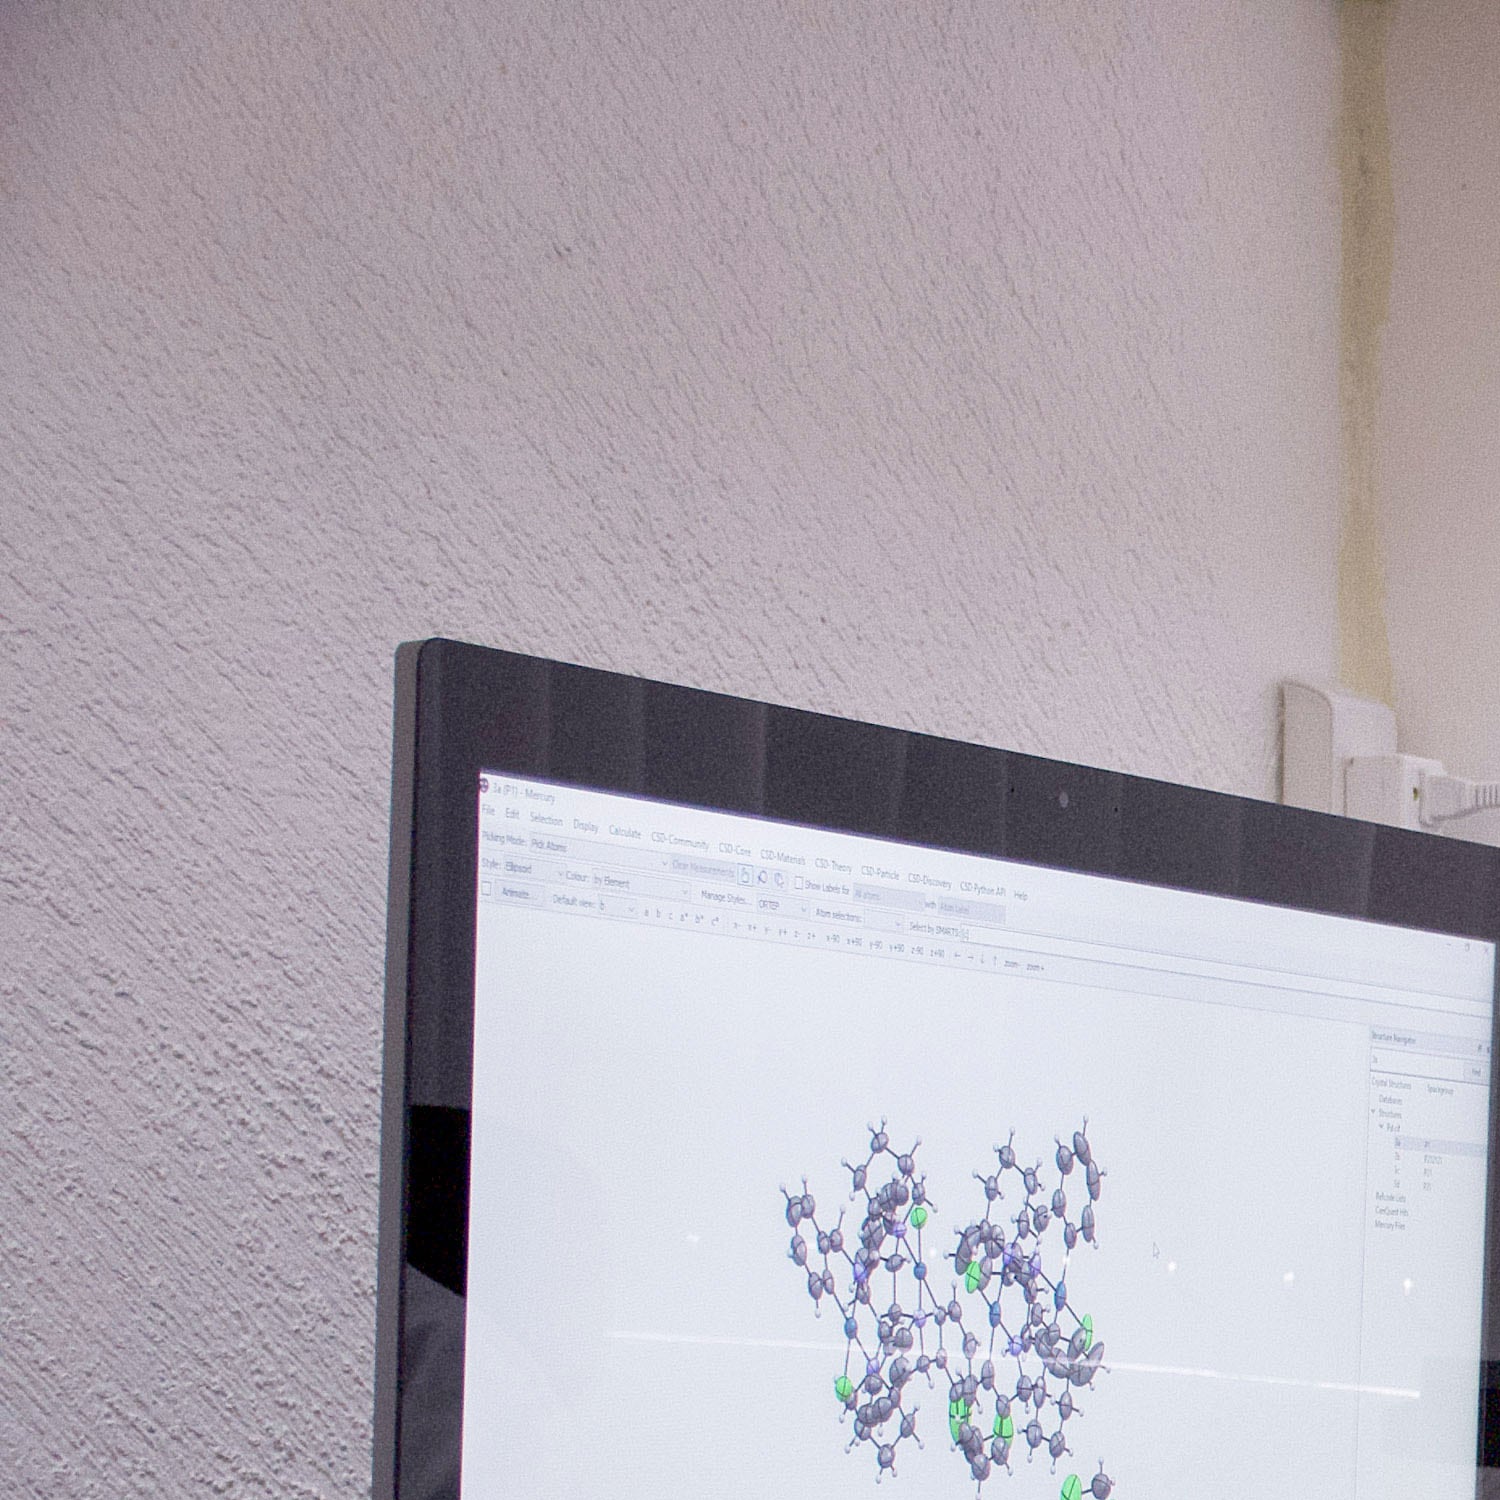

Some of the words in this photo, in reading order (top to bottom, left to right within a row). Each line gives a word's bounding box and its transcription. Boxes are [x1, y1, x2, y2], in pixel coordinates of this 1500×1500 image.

[525, 789, 556, 806] Mercury
[482, 804, 496, 816] File
[505, 808, 520, 820] Edit
[530, 812, 564, 827] Selection
[573, 819, 599, 835] Display
[608, 825, 642, 840] Calculate
[651, 831, 709, 851] CSD-Community
[719, 842, 752, 857] CSD-Core
[760, 849, 806, 866] CSD-Materials
[815, 857, 852, 876] CSD-Theory
[861, 865, 900, 881] CSD-Particle
[908, 873, 952, 891] CSD-Discovery
[805, 879, 821, 891] Show
[822, 882, 841, 895] Labels
[553, 893, 579, 907] Default
[1013, 890, 1029, 902] Help
